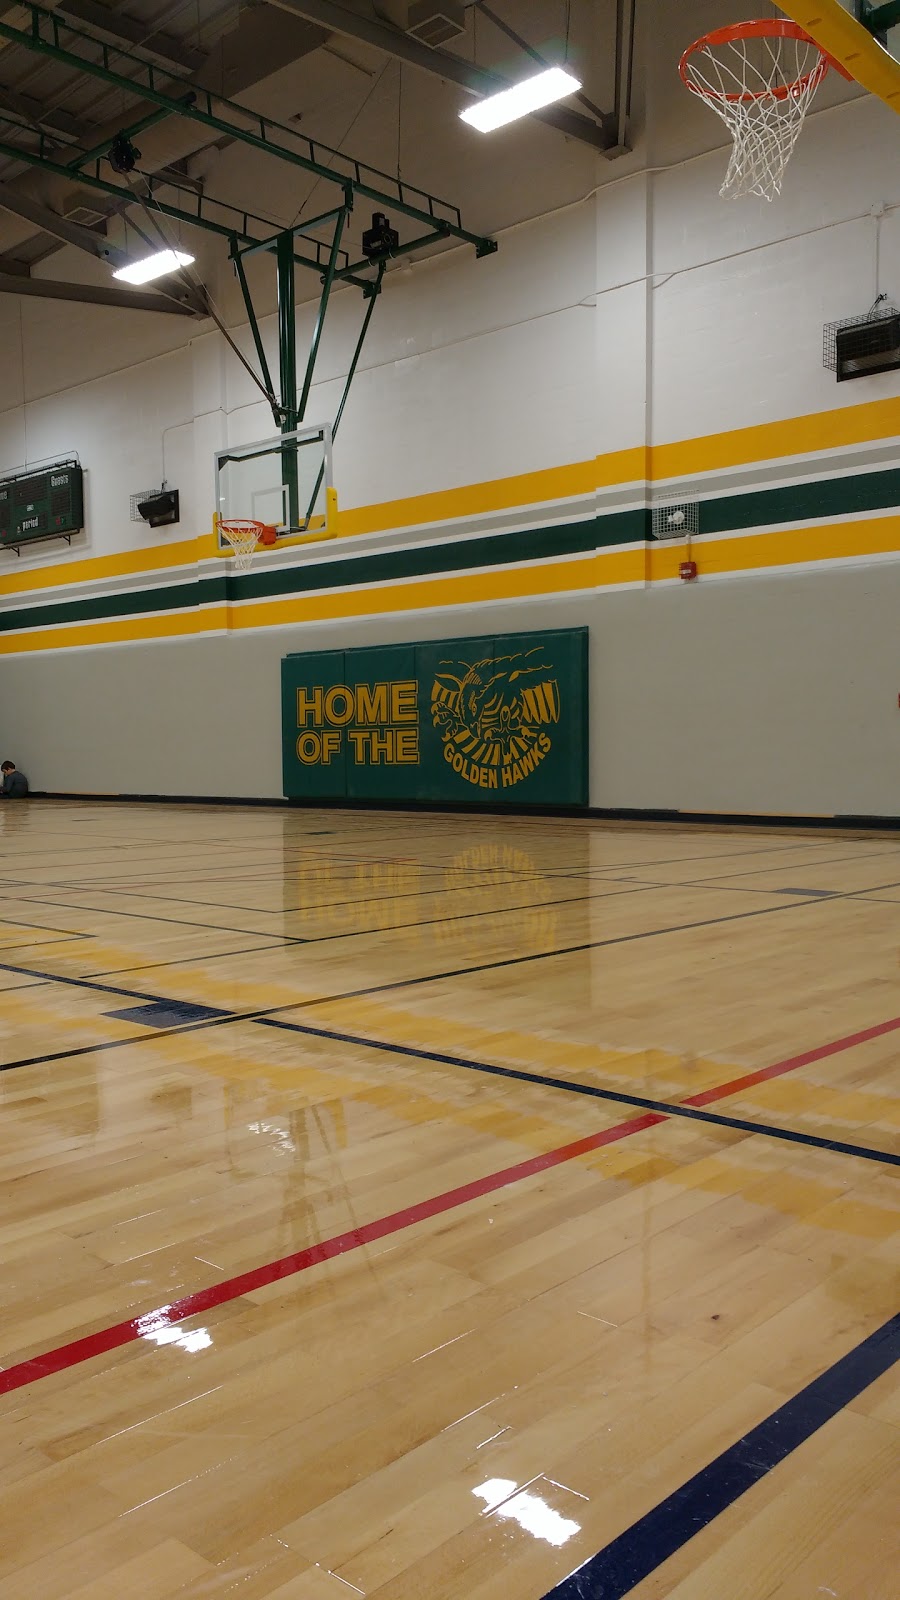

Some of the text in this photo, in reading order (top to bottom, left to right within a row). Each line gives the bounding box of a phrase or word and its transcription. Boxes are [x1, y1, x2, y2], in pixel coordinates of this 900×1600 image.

[51, 475, 69, 487] Guests
[296, 679, 419, 728] HOME
[296, 727, 420, 765] OF THE
[443, 732, 551, 789] GOLDEN HAWKS
